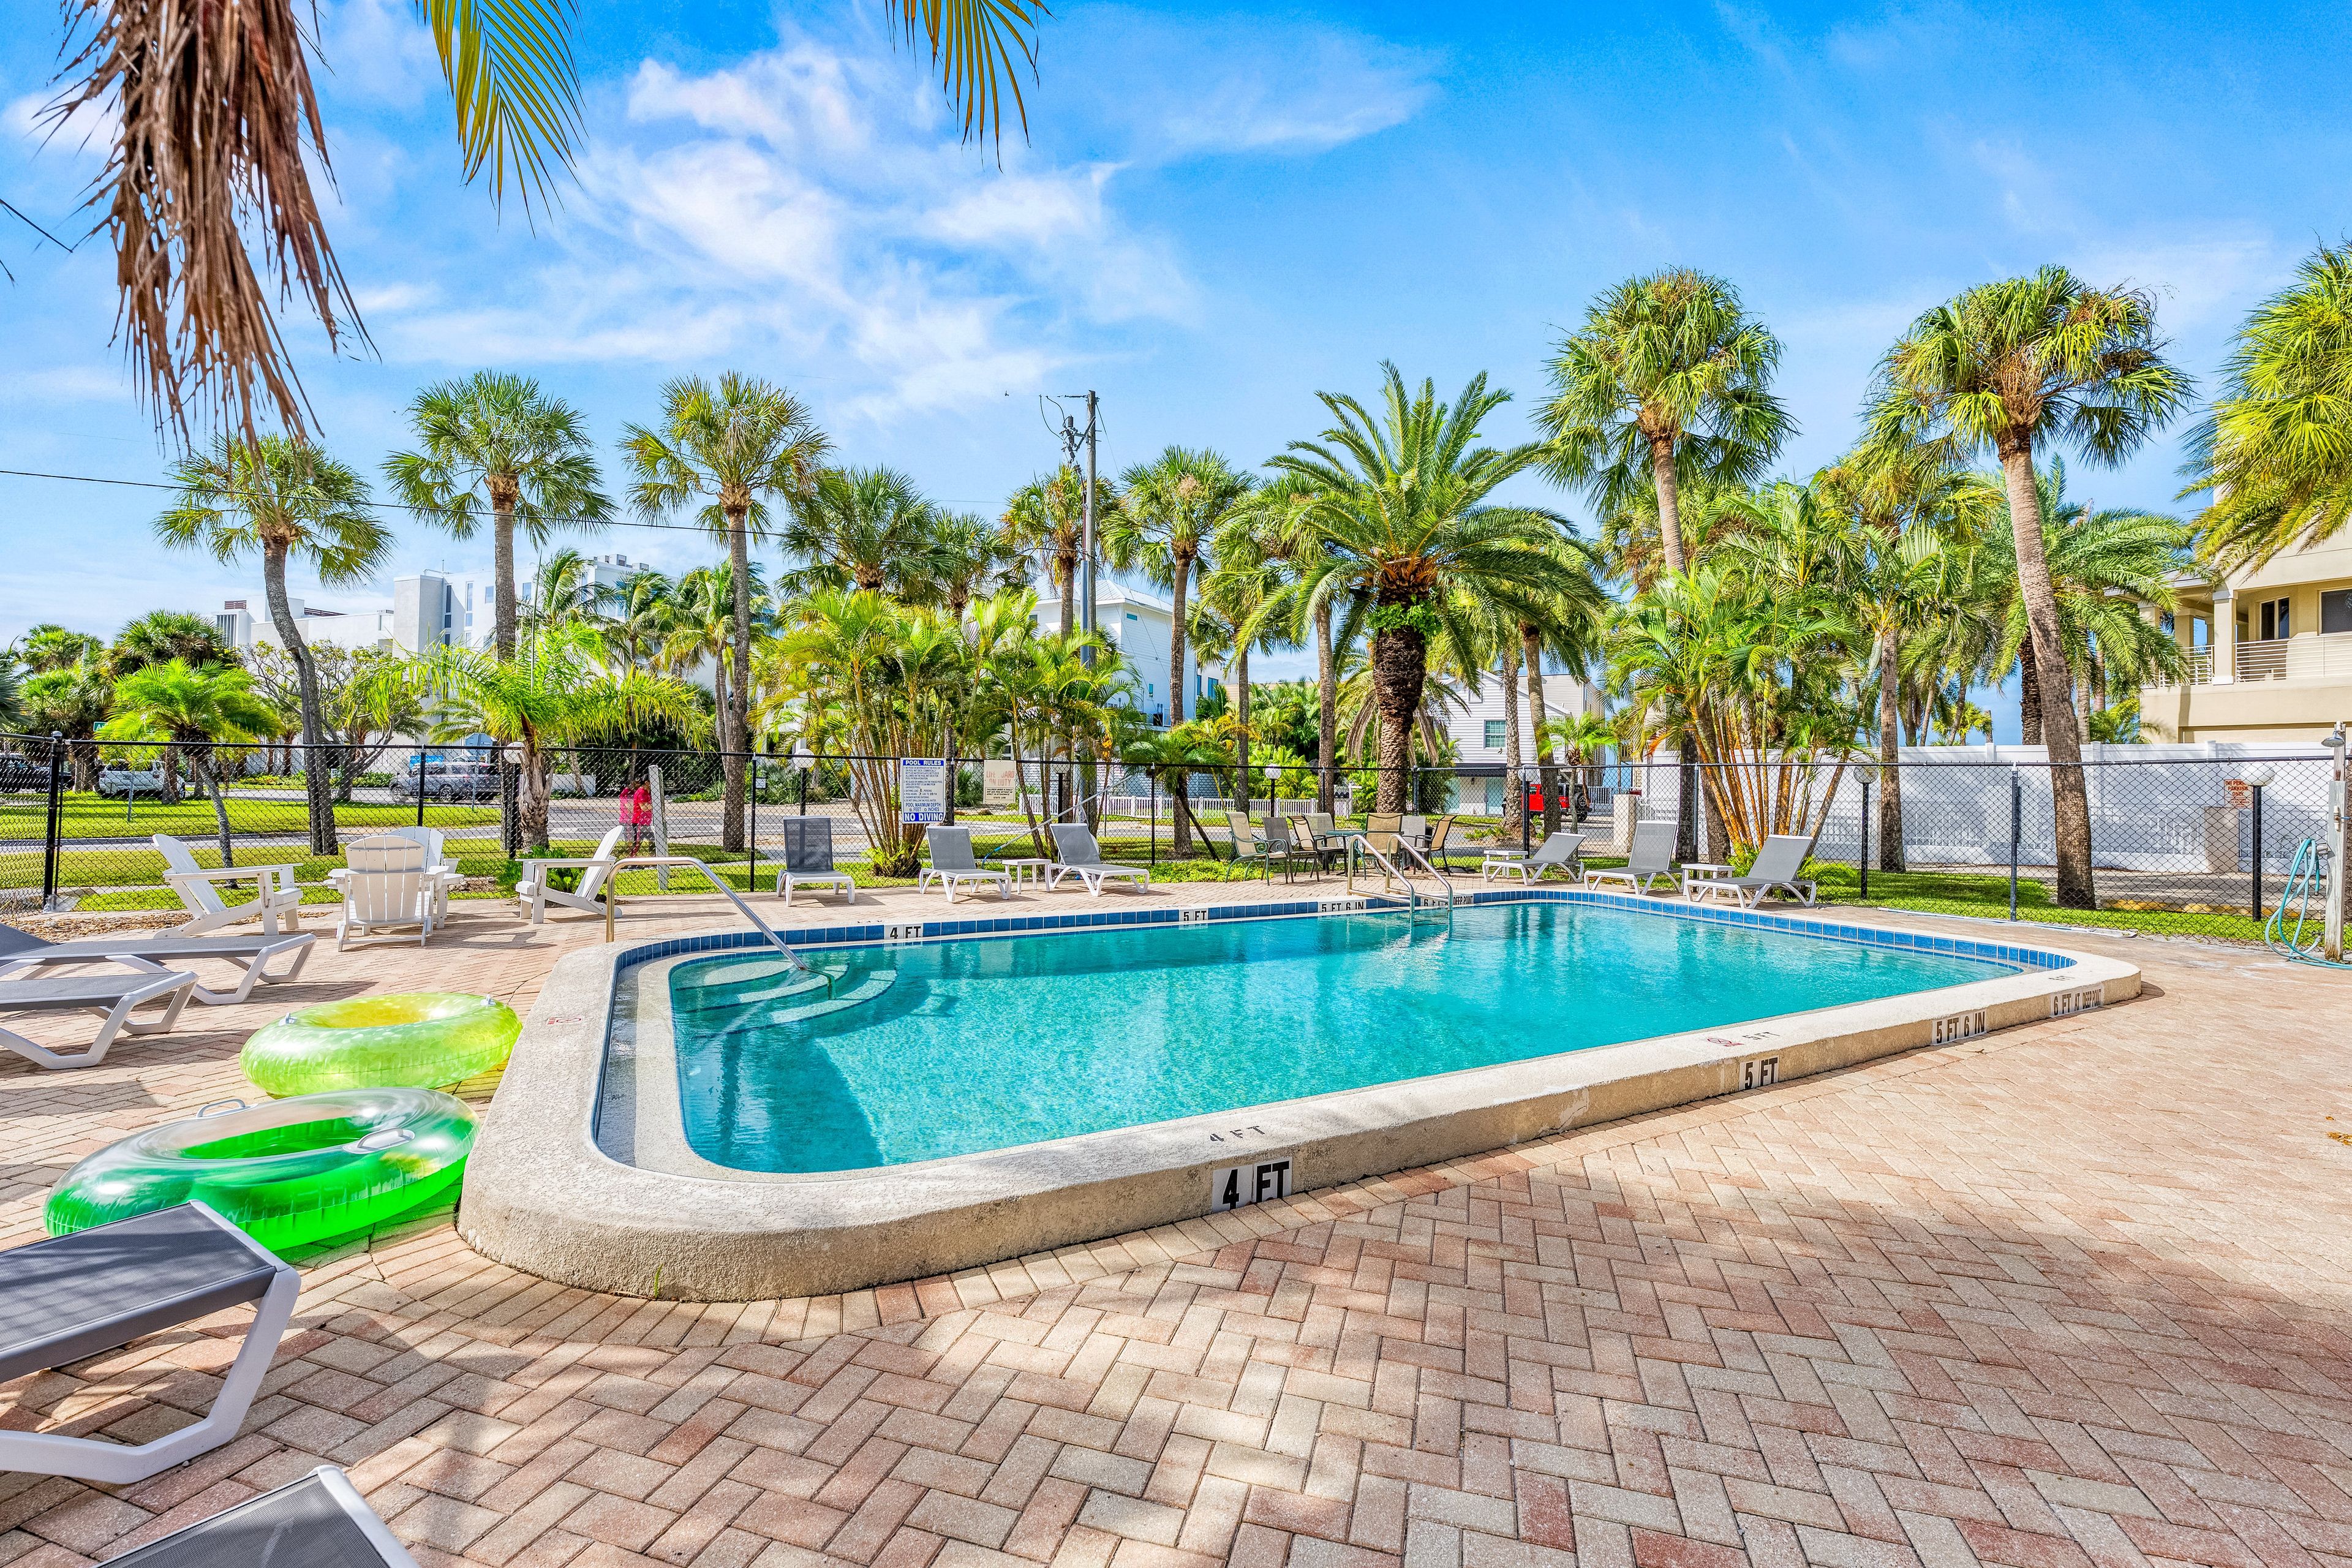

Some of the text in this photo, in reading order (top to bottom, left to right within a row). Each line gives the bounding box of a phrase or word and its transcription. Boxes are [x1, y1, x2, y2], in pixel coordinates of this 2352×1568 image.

[1184, 911, 1189, 921] 5
[1322, 901, 1364, 912] 5 FT 6 IN
[890, 927, 898, 939] 4
[2054, 989, 2101, 1016] 6 FT AT DEEP POINT
[1936, 1011, 1985, 1044] 5 FT 6 IN
[1745, 1057, 1778, 1089] 5 FT
[1223, 1161, 1290, 1211] 4 FT
